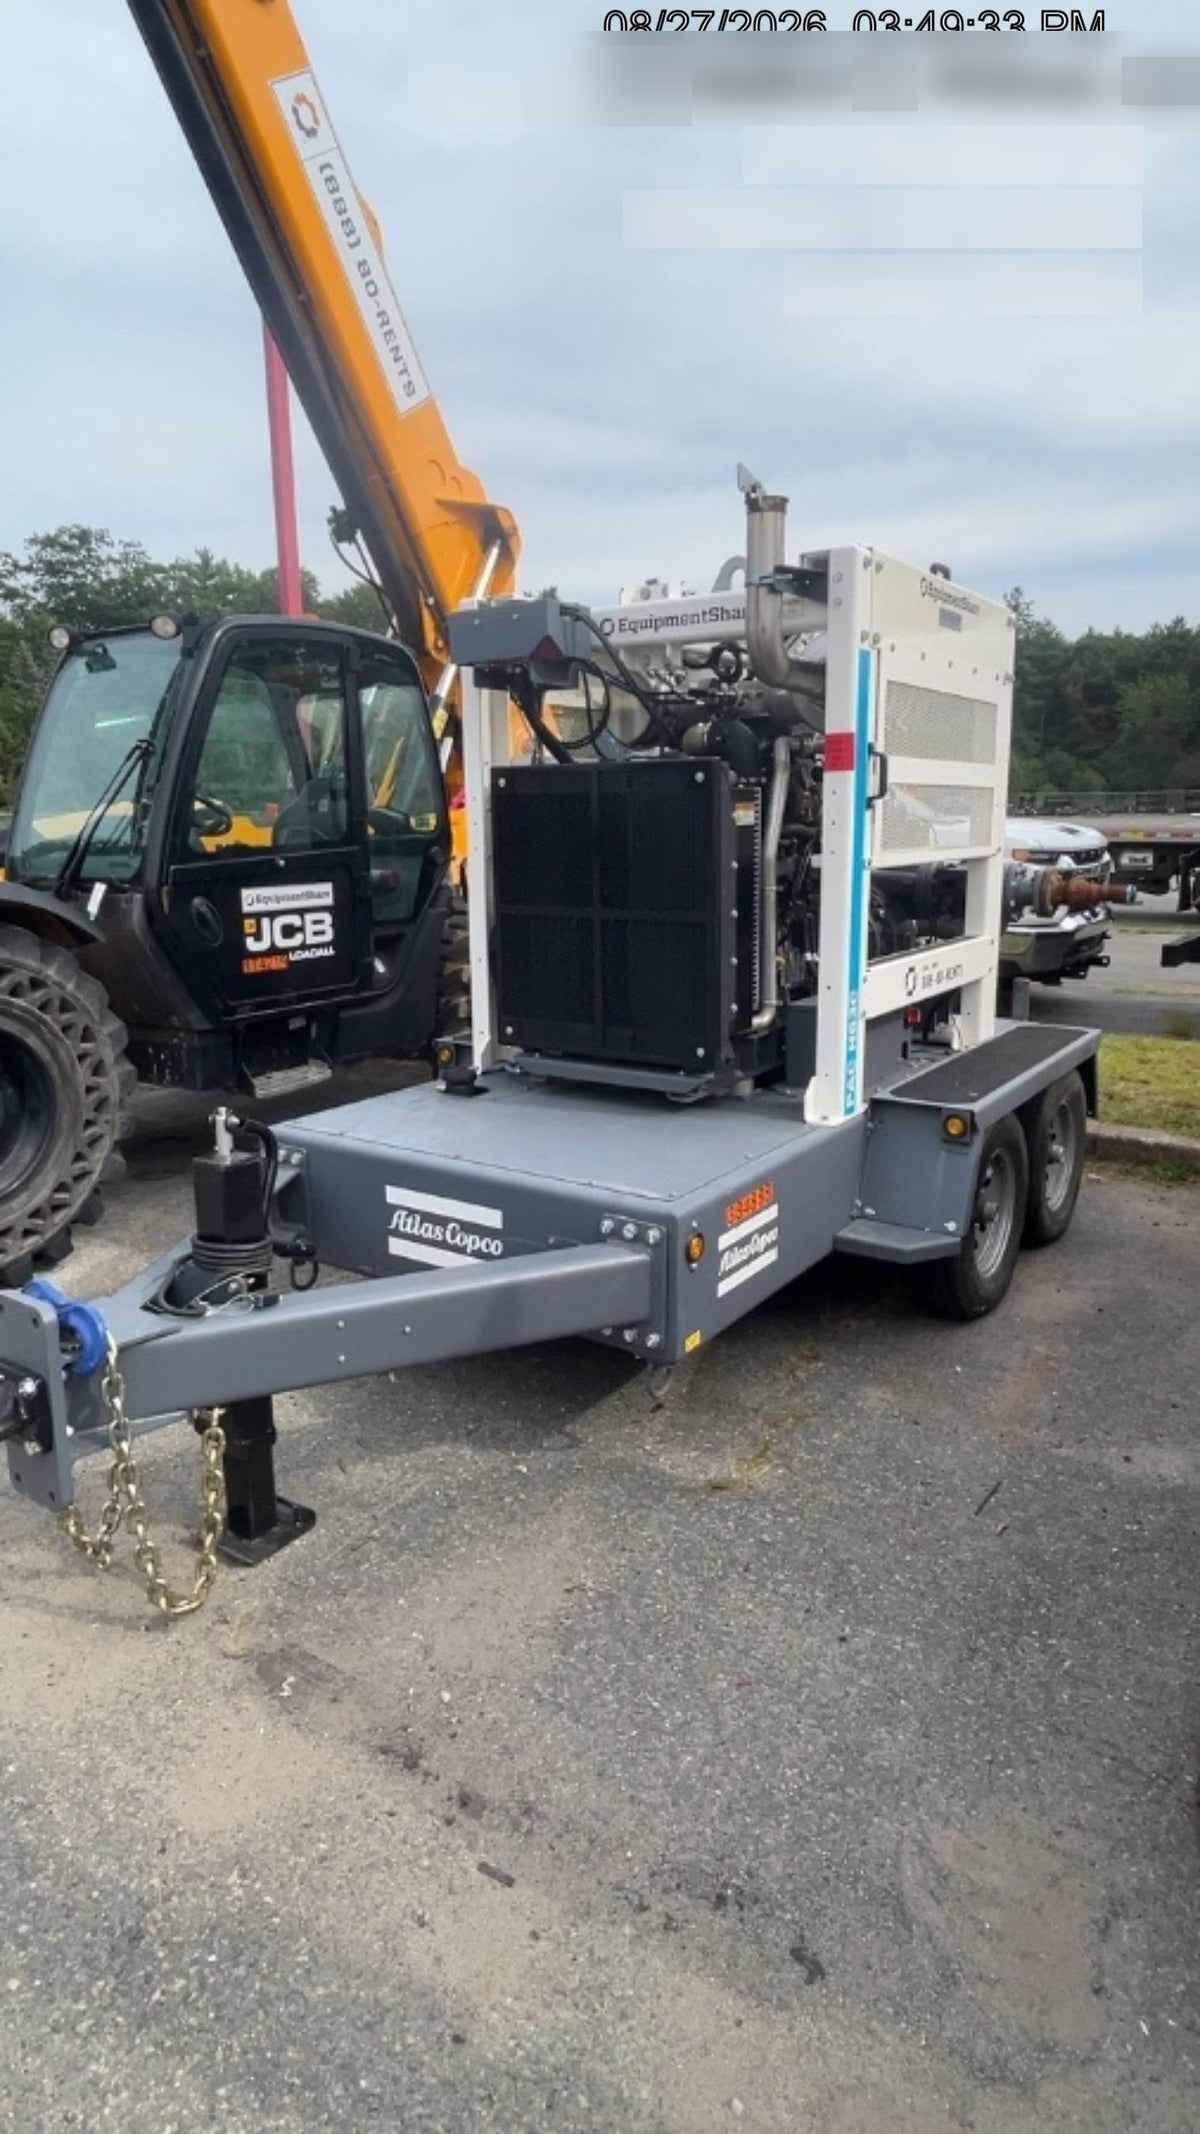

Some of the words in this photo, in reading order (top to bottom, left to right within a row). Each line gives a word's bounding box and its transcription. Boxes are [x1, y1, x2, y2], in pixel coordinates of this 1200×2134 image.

[319, 162, 361, 250] (888)
[243, 911, 335, 951] JCB
[387, 1208, 444, 1242] Atlas
[444, 1222, 504, 1256] Copco
